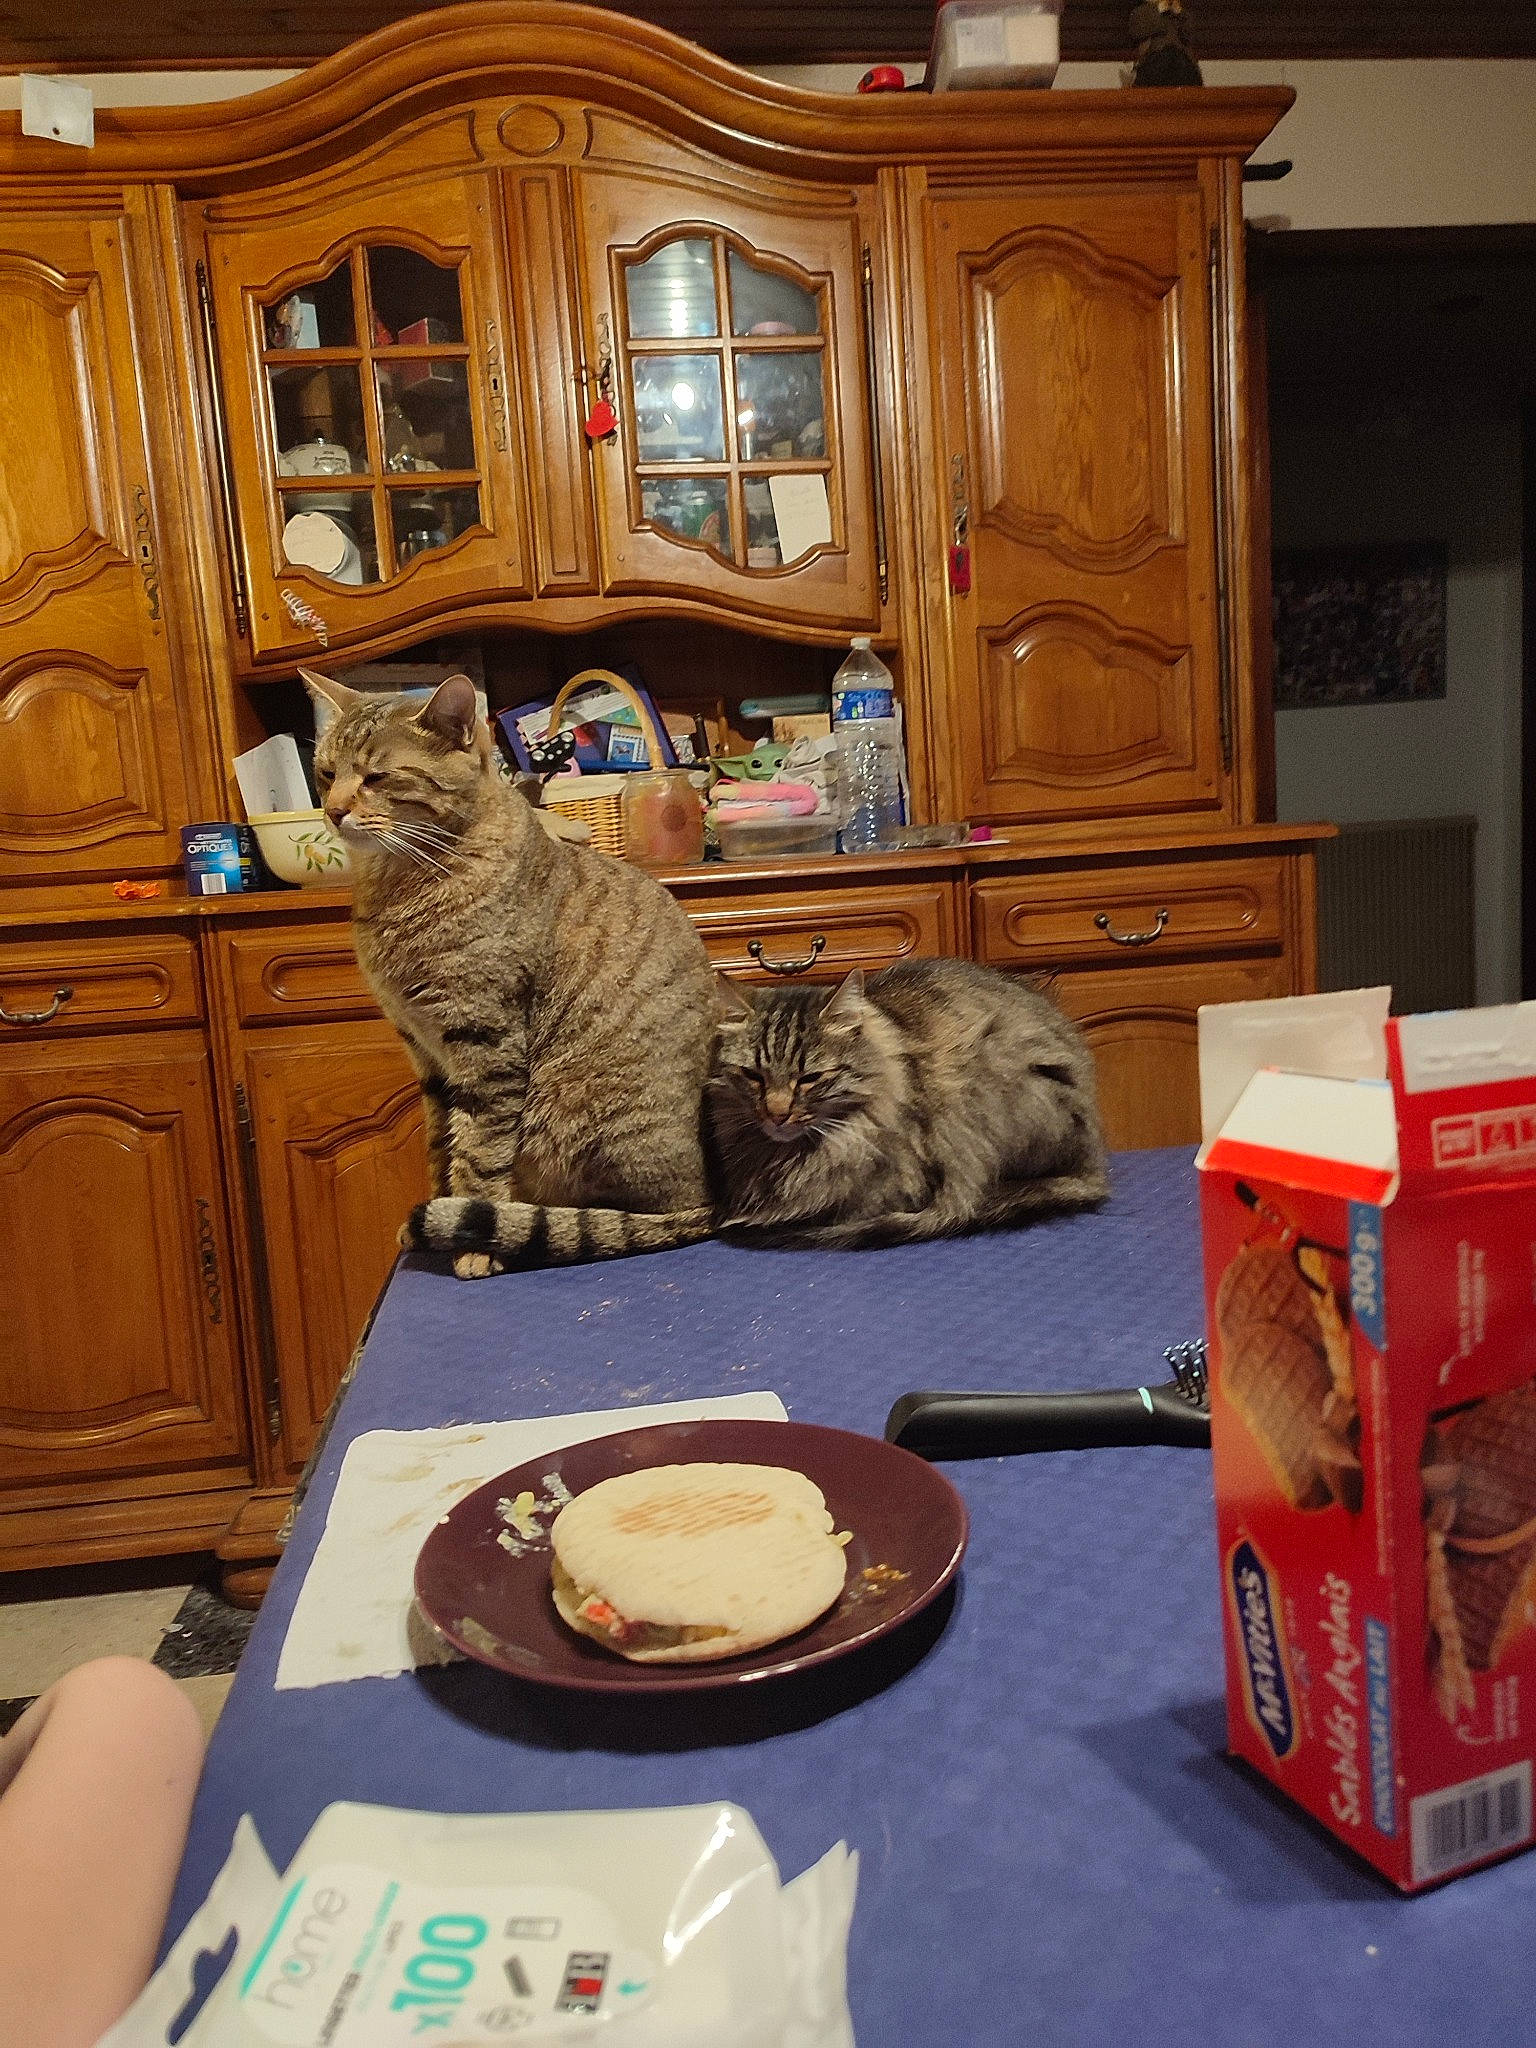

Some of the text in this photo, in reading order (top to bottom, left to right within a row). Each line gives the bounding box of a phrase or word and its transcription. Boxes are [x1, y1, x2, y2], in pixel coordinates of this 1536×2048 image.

[187, 843, 233, 854] OPTIQUES
[1350, 1232, 1381, 1316] 300g
[253, 1887, 347, 2009] home
